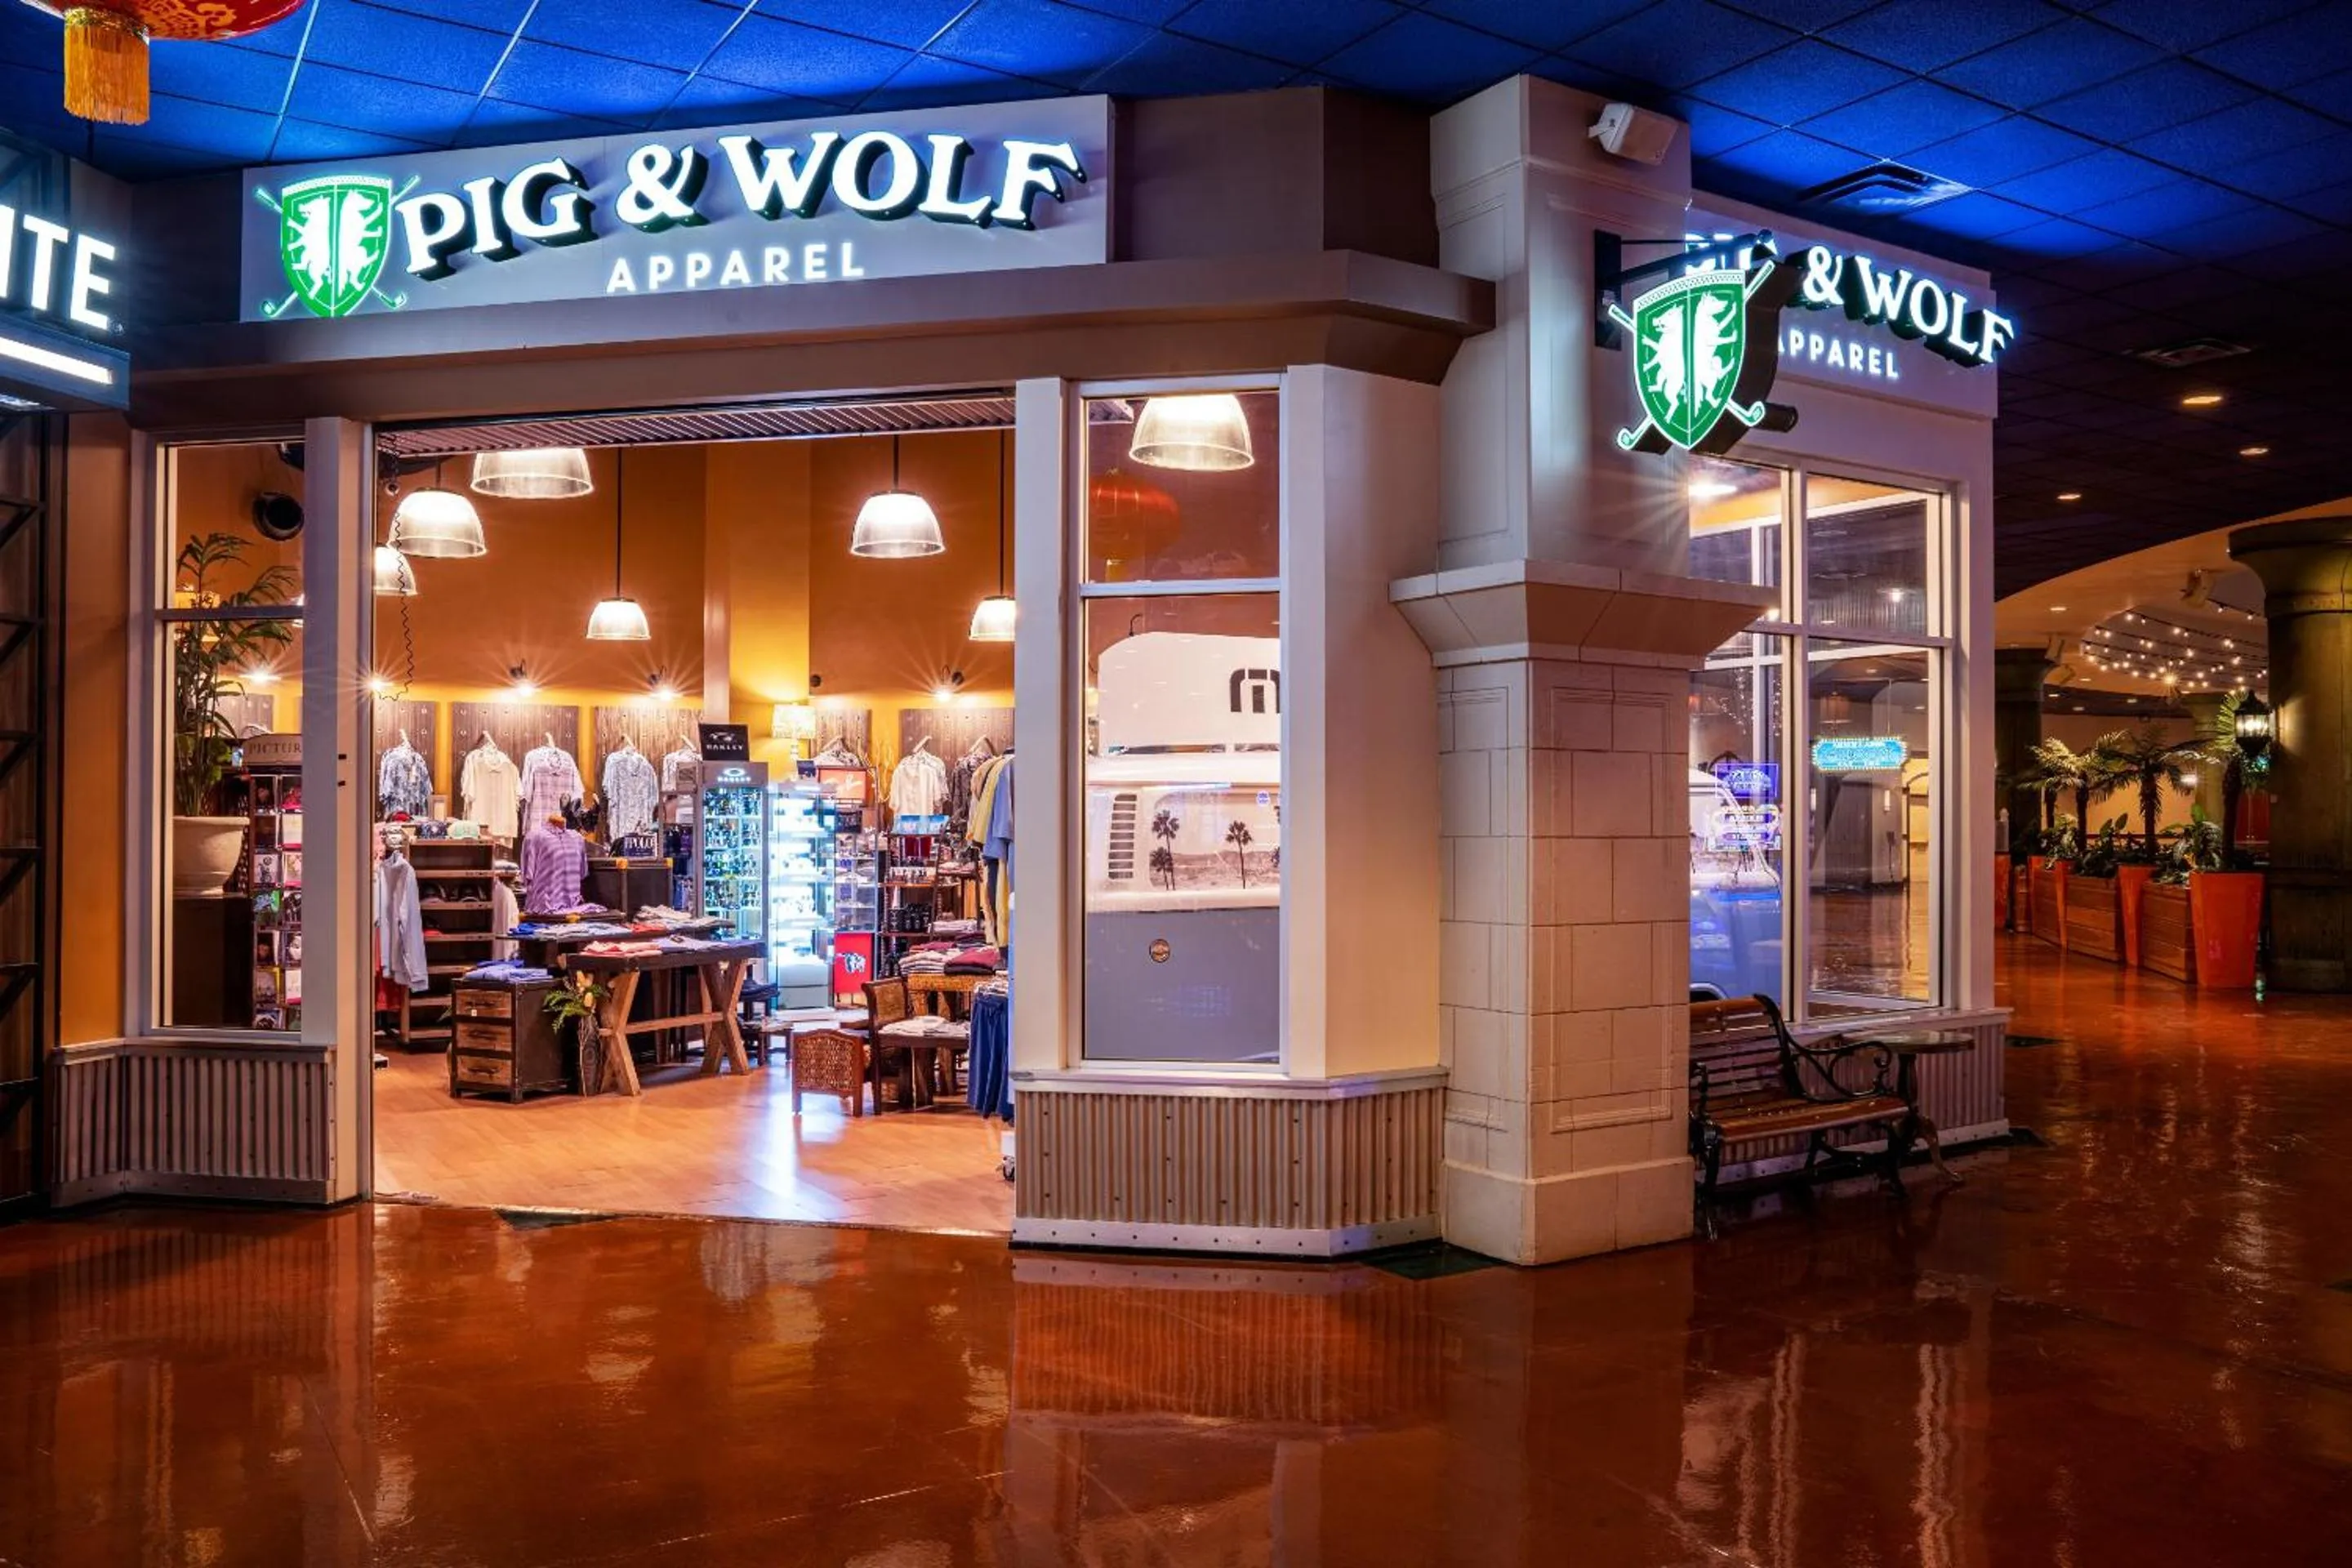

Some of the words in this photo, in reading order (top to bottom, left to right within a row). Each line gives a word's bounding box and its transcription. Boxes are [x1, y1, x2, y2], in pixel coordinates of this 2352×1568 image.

[394, 157, 582, 273] PIG
[615, 143, 695, 225] &
[717, 131, 1080, 220] WOLF
[606, 243, 865, 294] APPAREL
[1802, 245, 1845, 305] &
[1855, 254, 2016, 363] WOLF
